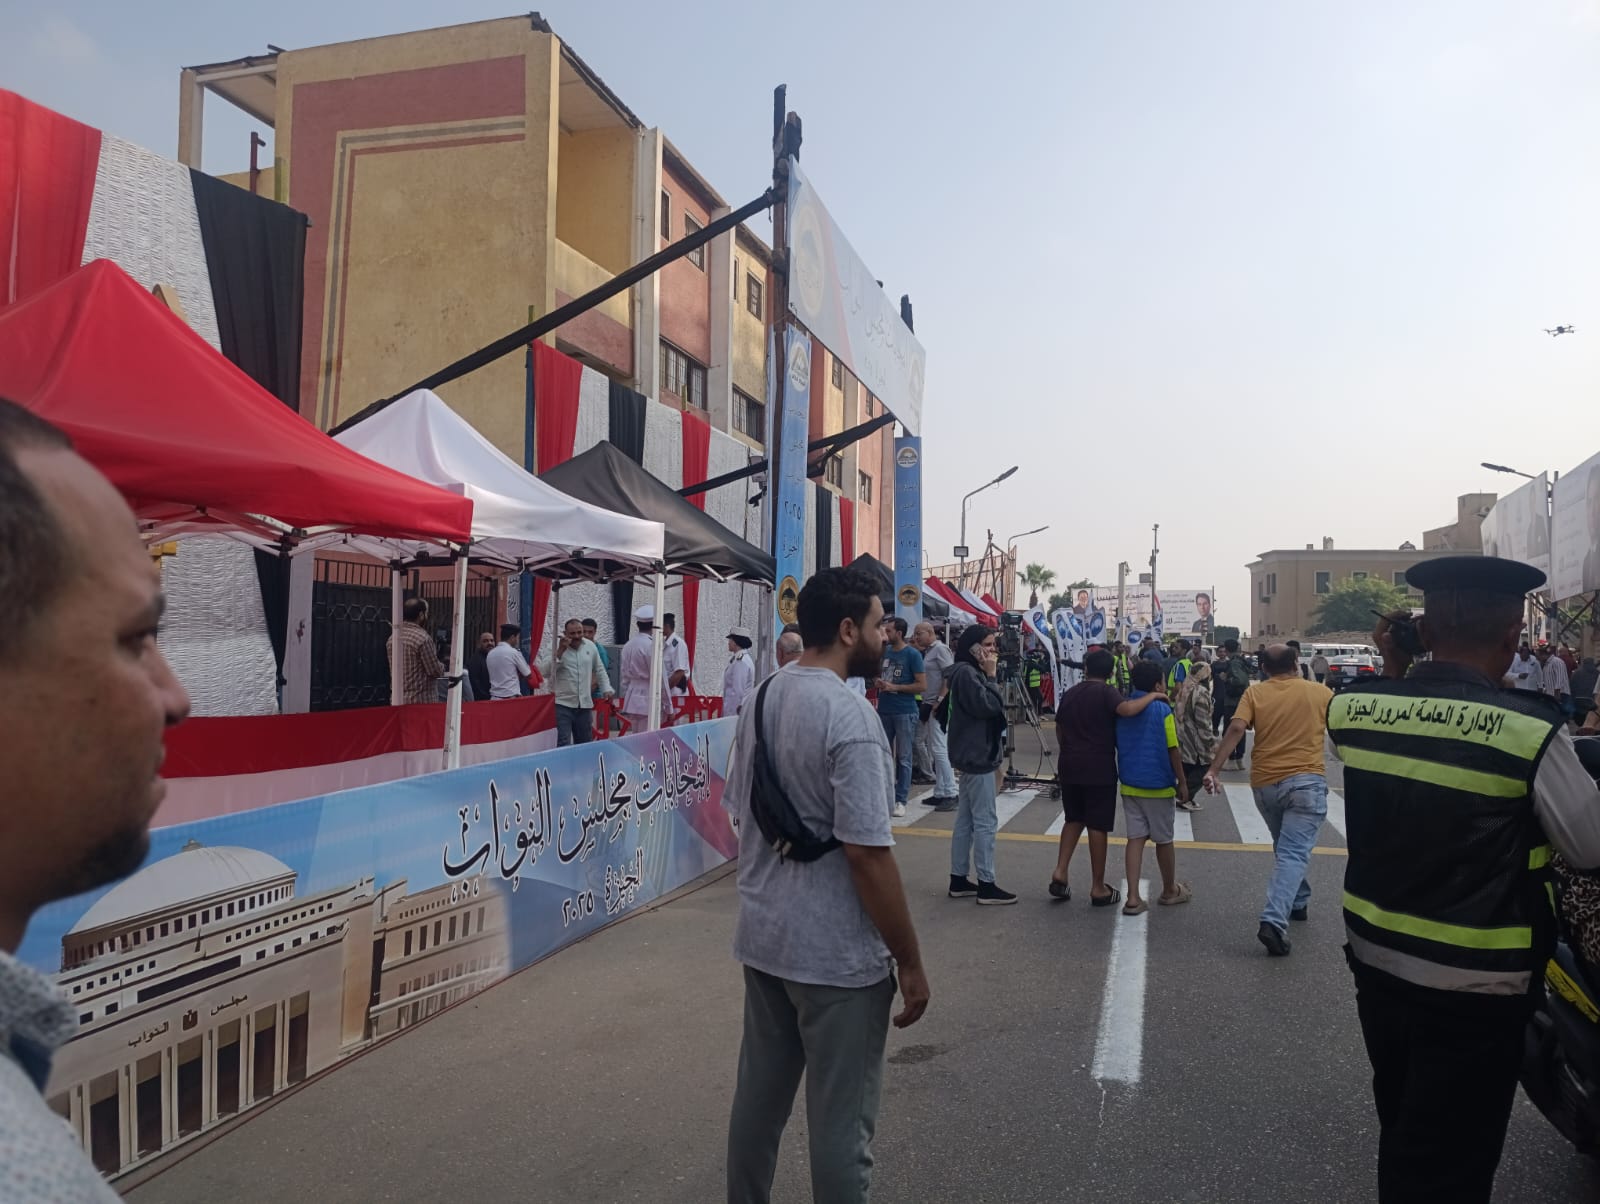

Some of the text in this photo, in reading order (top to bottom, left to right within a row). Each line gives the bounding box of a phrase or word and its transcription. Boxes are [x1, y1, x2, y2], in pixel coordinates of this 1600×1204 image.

[1346, 697, 1505, 741] الإدارة العامة لمرور الجيزة
[442, 767, 553, 903] النواب
[557, 752, 632, 863] مجلس
[561, 847, 644, 928] الجيزة ٢٠٢٥
[127, 994, 248, 1048] مجلس النواب
